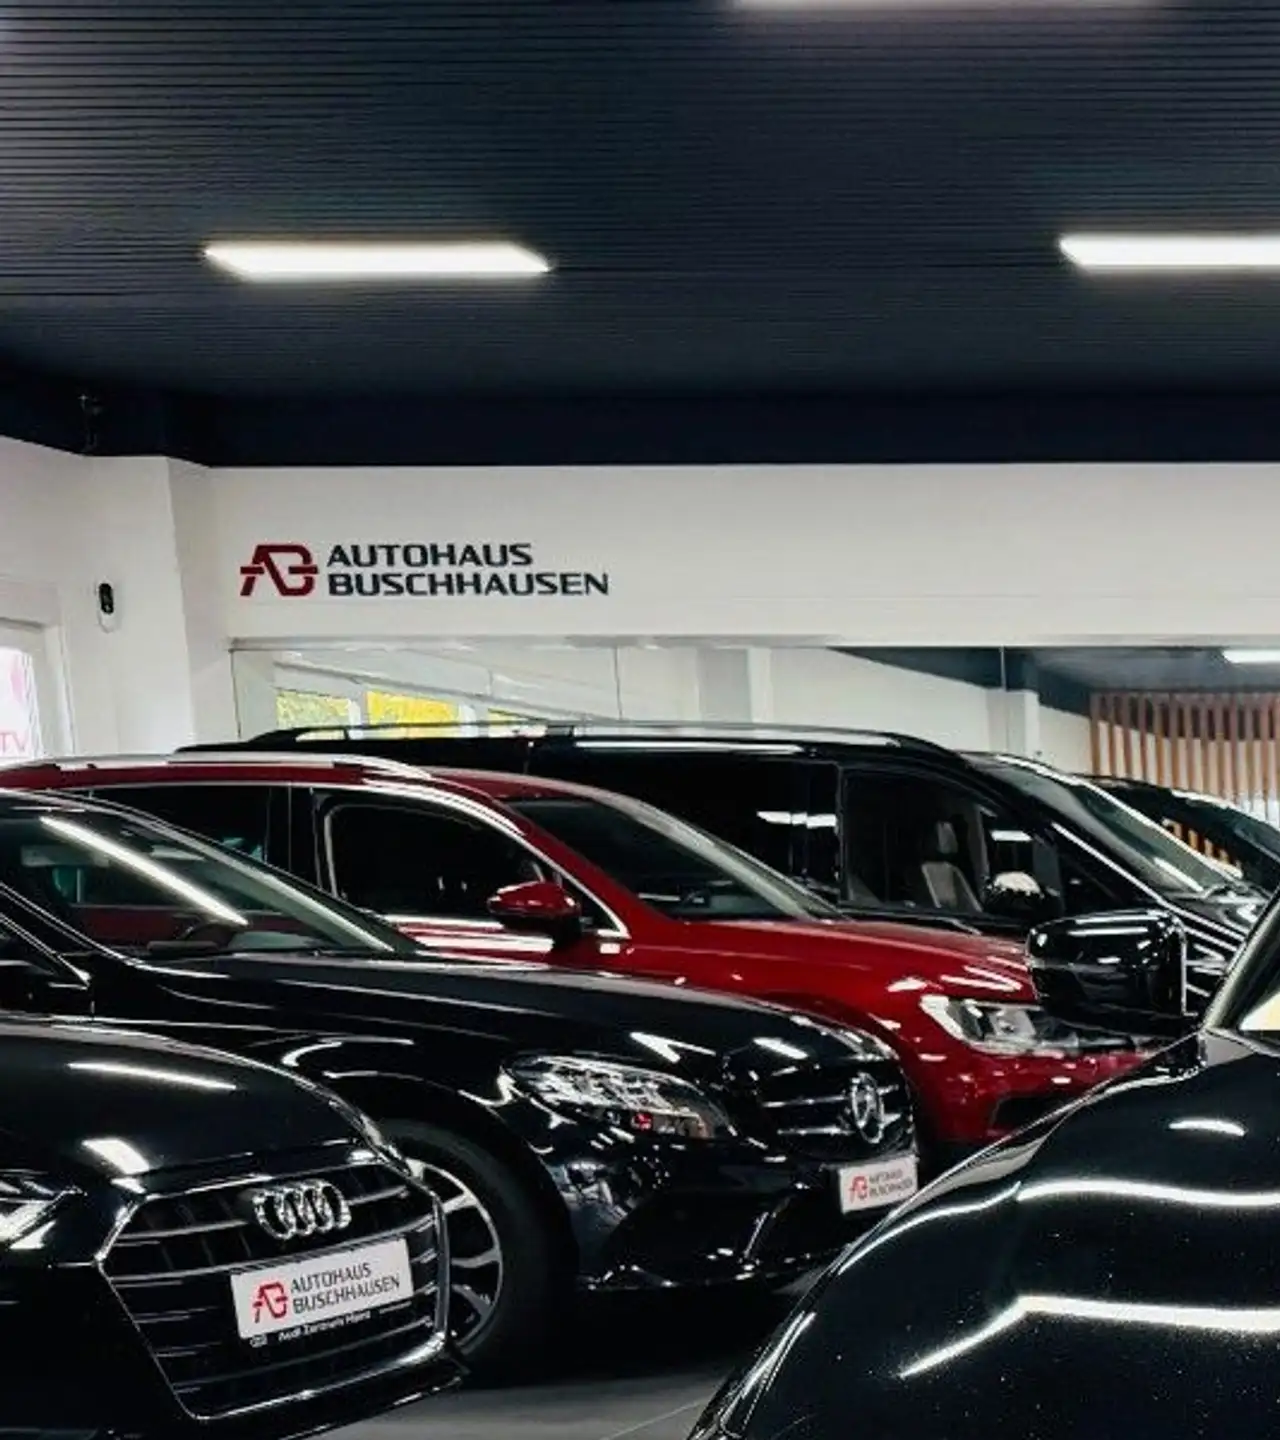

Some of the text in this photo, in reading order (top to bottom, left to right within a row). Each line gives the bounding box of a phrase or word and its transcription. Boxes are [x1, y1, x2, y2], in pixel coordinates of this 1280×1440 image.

[327, 543, 533, 568] AUTOHAUS
[327, 572, 610, 597] BUSCHHAUSEN
[290, 1262, 372, 1294] AUTOHAUS
[293, 1274, 401, 1314] BUSCHHAUSEN
